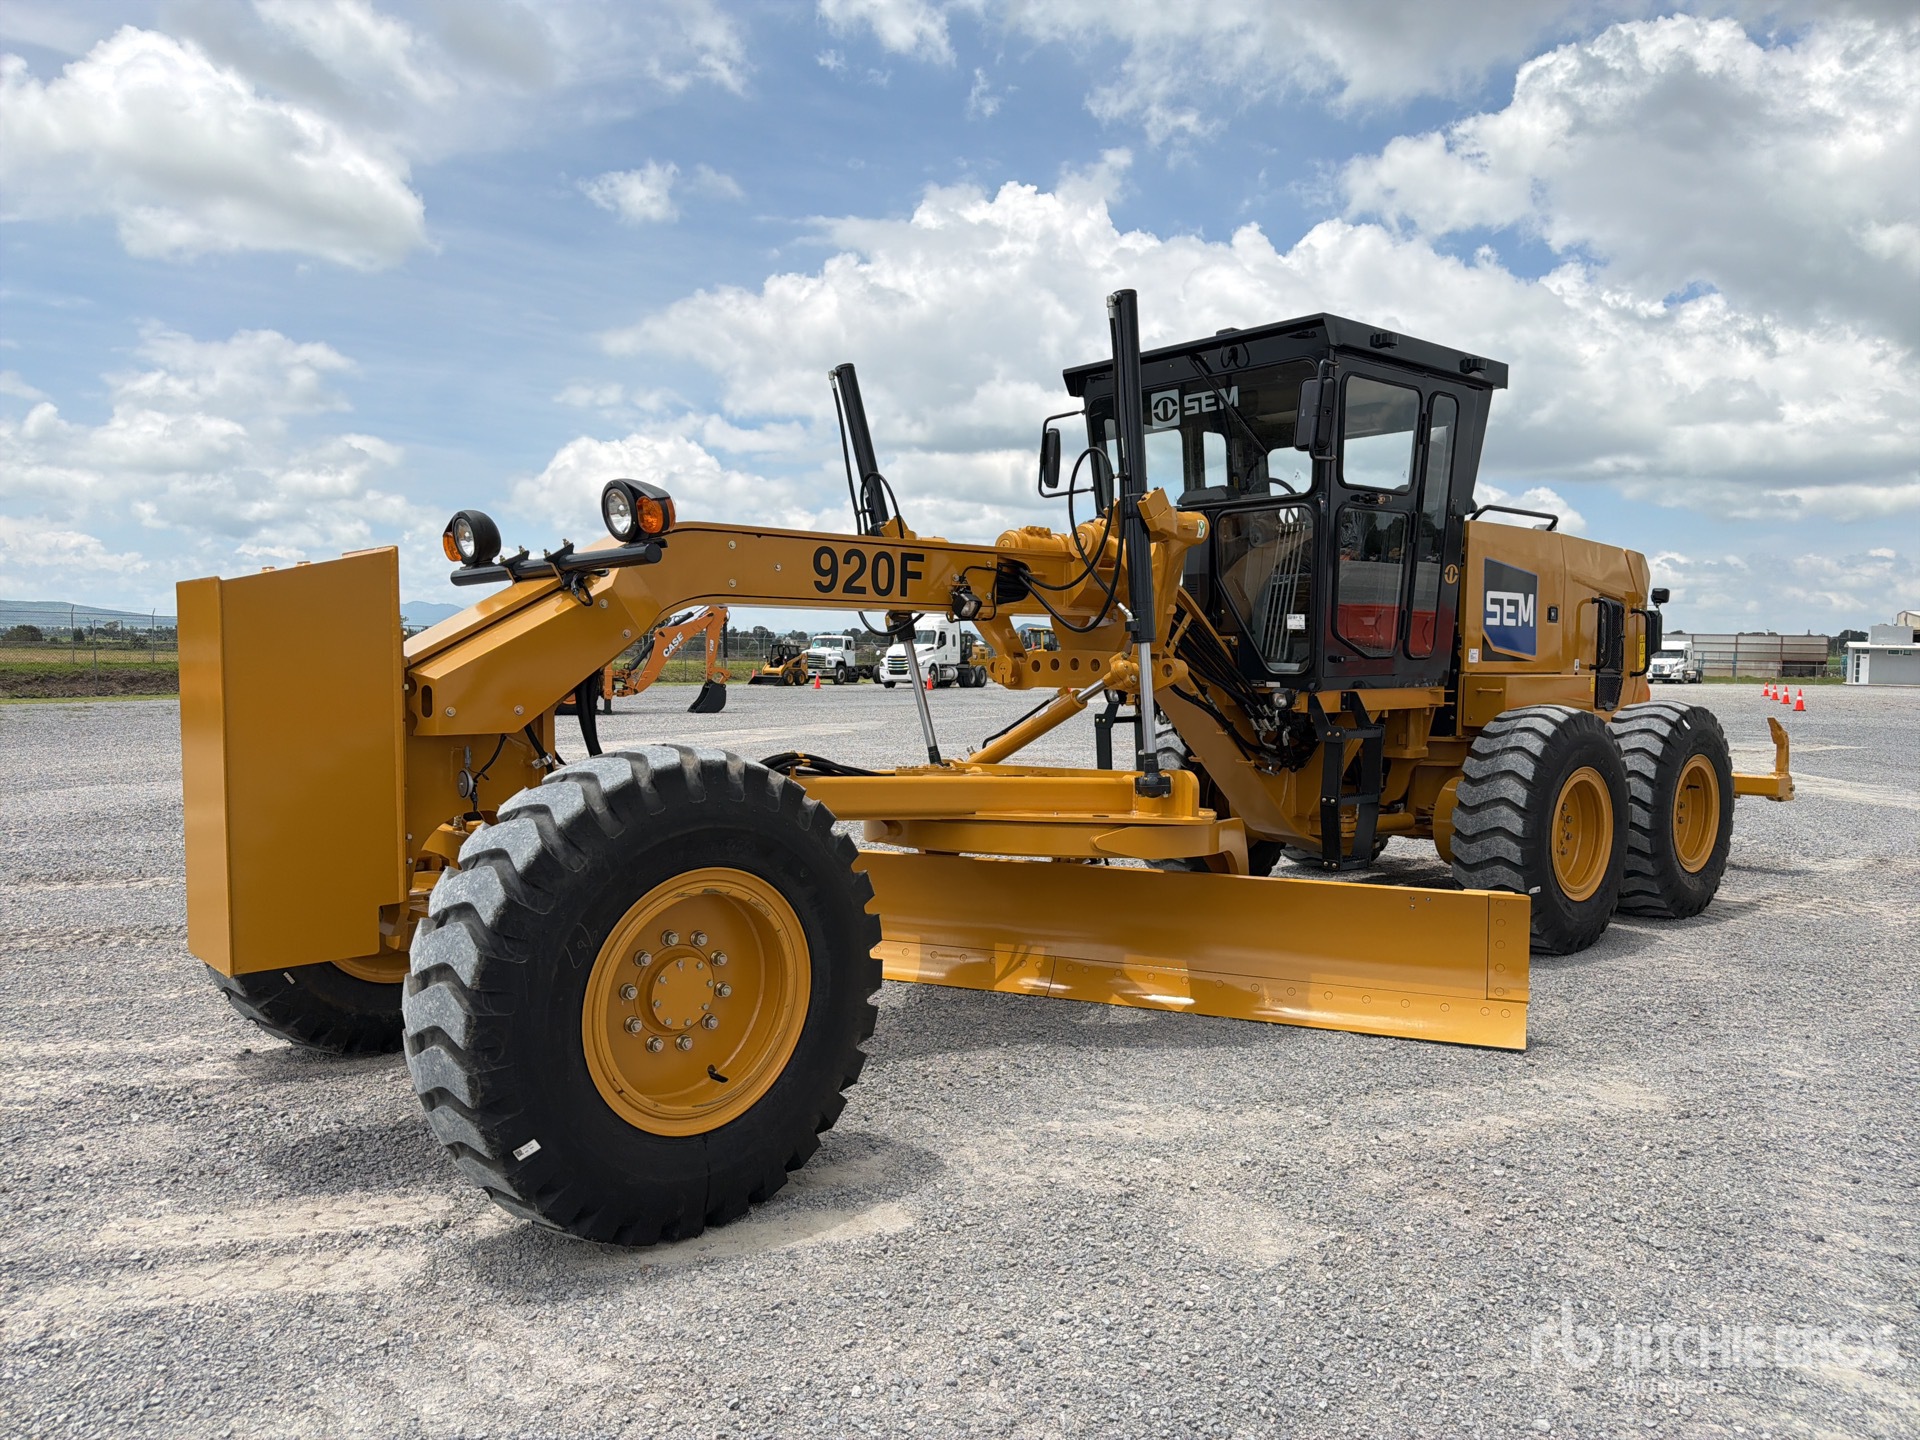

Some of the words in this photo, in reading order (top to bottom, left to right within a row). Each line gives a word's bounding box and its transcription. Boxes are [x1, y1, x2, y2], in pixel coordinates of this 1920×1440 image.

[1184, 386, 1239, 416] SEM
[813, 546, 925, 597] 920F
[1485, 590, 1535, 627] SEM
[663, 632, 684, 657] CASE
